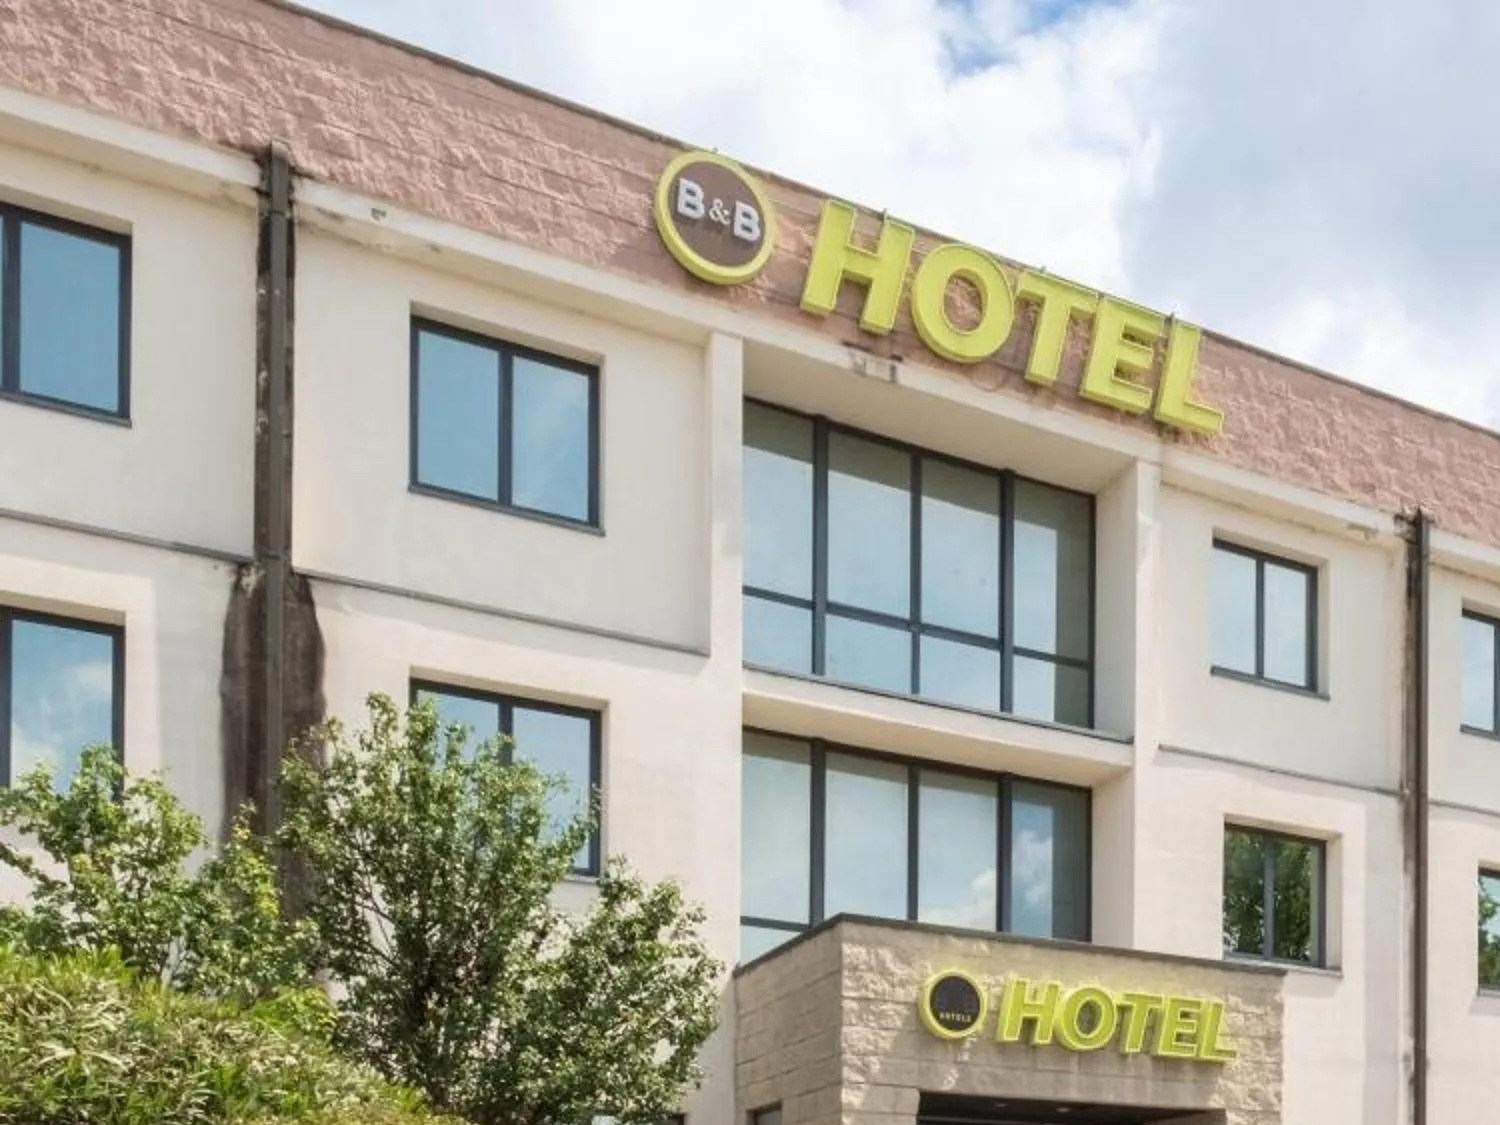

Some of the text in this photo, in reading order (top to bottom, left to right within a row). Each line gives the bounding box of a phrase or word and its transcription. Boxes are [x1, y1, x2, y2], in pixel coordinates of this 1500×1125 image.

[677, 177, 1224, 435] B&B HOTEL
[997, 976, 1237, 1063] HOTEL
